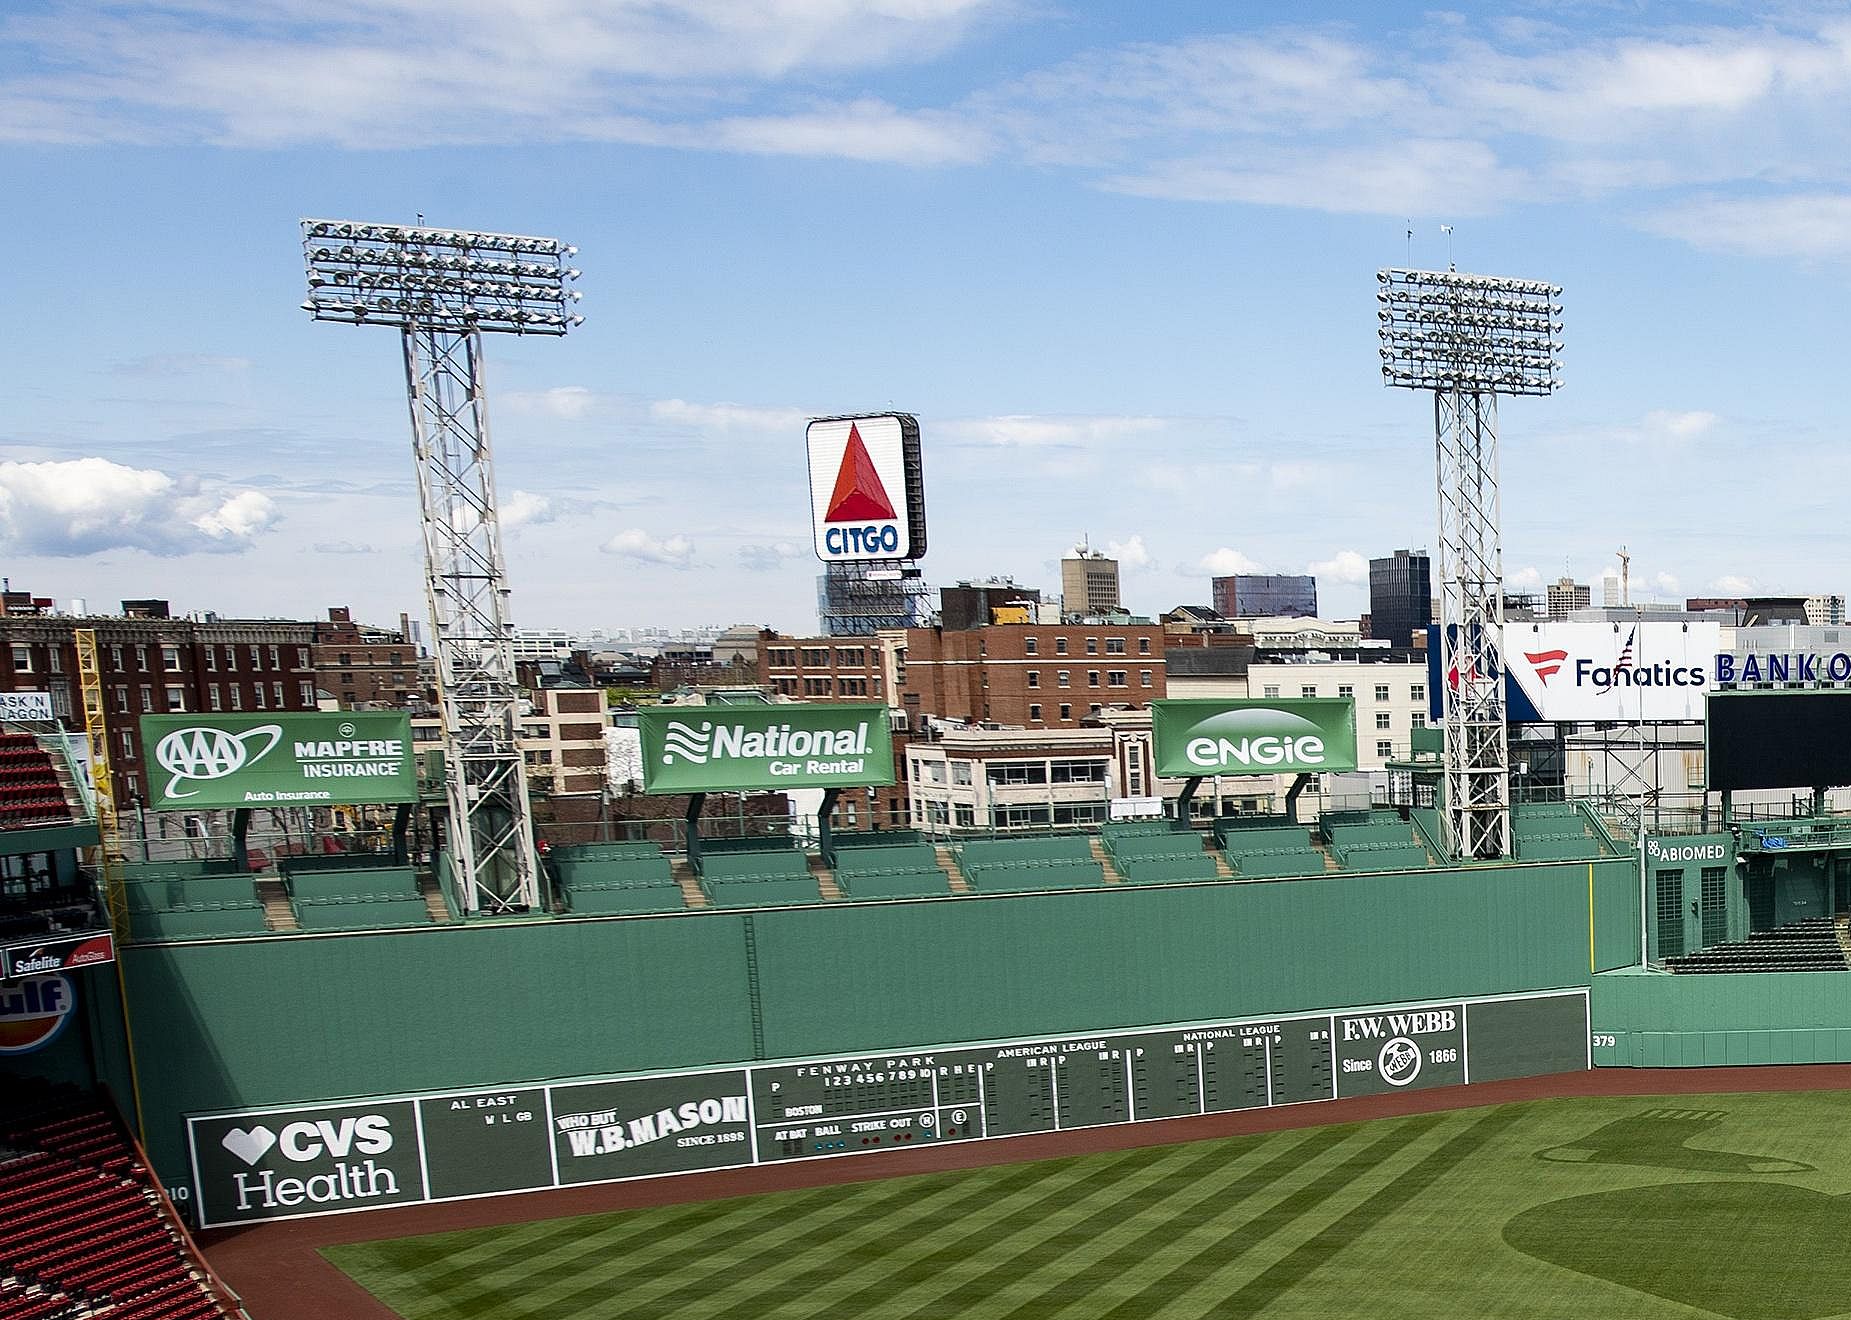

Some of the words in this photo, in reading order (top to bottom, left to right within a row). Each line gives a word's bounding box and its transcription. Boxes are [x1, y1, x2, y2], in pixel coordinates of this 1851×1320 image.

[826, 525, 898, 554] CITGO
[1575, 659, 1706, 688] Fanatics
[1716, 652, 1817, 683] BANK
[293, 740, 403, 758] MAPFRE
[712, 721, 868, 760] National
[168, 730, 235, 776] AAA
[303, 761, 400, 778] INSURANCE
[769, 758, 802, 776] Car
[806, 757, 864, 776] Rental
[244, 791, 274, 802] Auto
[275, 790, 331, 801] Insurance
[1660, 843, 1725, 863] ABIOMED
[15, 955, 61, 973] Safelite
[1183, 1028, 1236, 1042] NATIONAL
[1239, 1024, 1281, 1037] LEAGUE
[1386, 1010, 1457, 1037] WEBB
[997, 1045, 1058, 1059] AMERICAN
[1062, 1040, 1108, 1053] LEAGUE
[1186, 1043, 1195, 1052] R
[1206, 1041, 1214, 1050] P
[1255, 1037, 1263, 1046] R
[1274, 1035, 1282, 1044] P
[1321, 1031, 1329, 1039] R
[1592, 1035, 1616, 1047] 379
[985, 1062, 994, 1072] P
[1040, 1057, 1049, 1066] R
[1058, 1055, 1066, 1065] P
[1112, 1050, 1121, 1059] R
[1136, 1048, 1144, 1058] P
[1429, 1048, 1457, 1064] 1866
[797, 1061, 874, 1078] FENWAY
[886, 1056, 936, 1069] PARK
[1342, 1058, 1373, 1074] Since
[771, 1082, 782, 1092] P
[940, 1066, 949, 1076] R
[967, 1064, 976, 1074] E
[450, 1099, 471, 1111] AL
[476, 1095, 517, 1108] EAST
[784, 1104, 823, 1117] BOSTON
[502, 1113, 512, 1123] L
[515, 1111, 533, 1122] GB
[557, 1114, 588, 1130] WHO
[590, 1111, 617, 1125] BUT
[279, 1114, 394, 1162] CVS
[775, 1131, 789, 1141] AT
[815, 1125, 842, 1138] BALL
[851, 1120, 888, 1133] STRIKE
[889, 1117, 913, 1128] OUT
[677, 1134, 716, 1148] SINCE
[716, 1131, 745, 1145] 1898
[233, 1159, 401, 1211] Health
